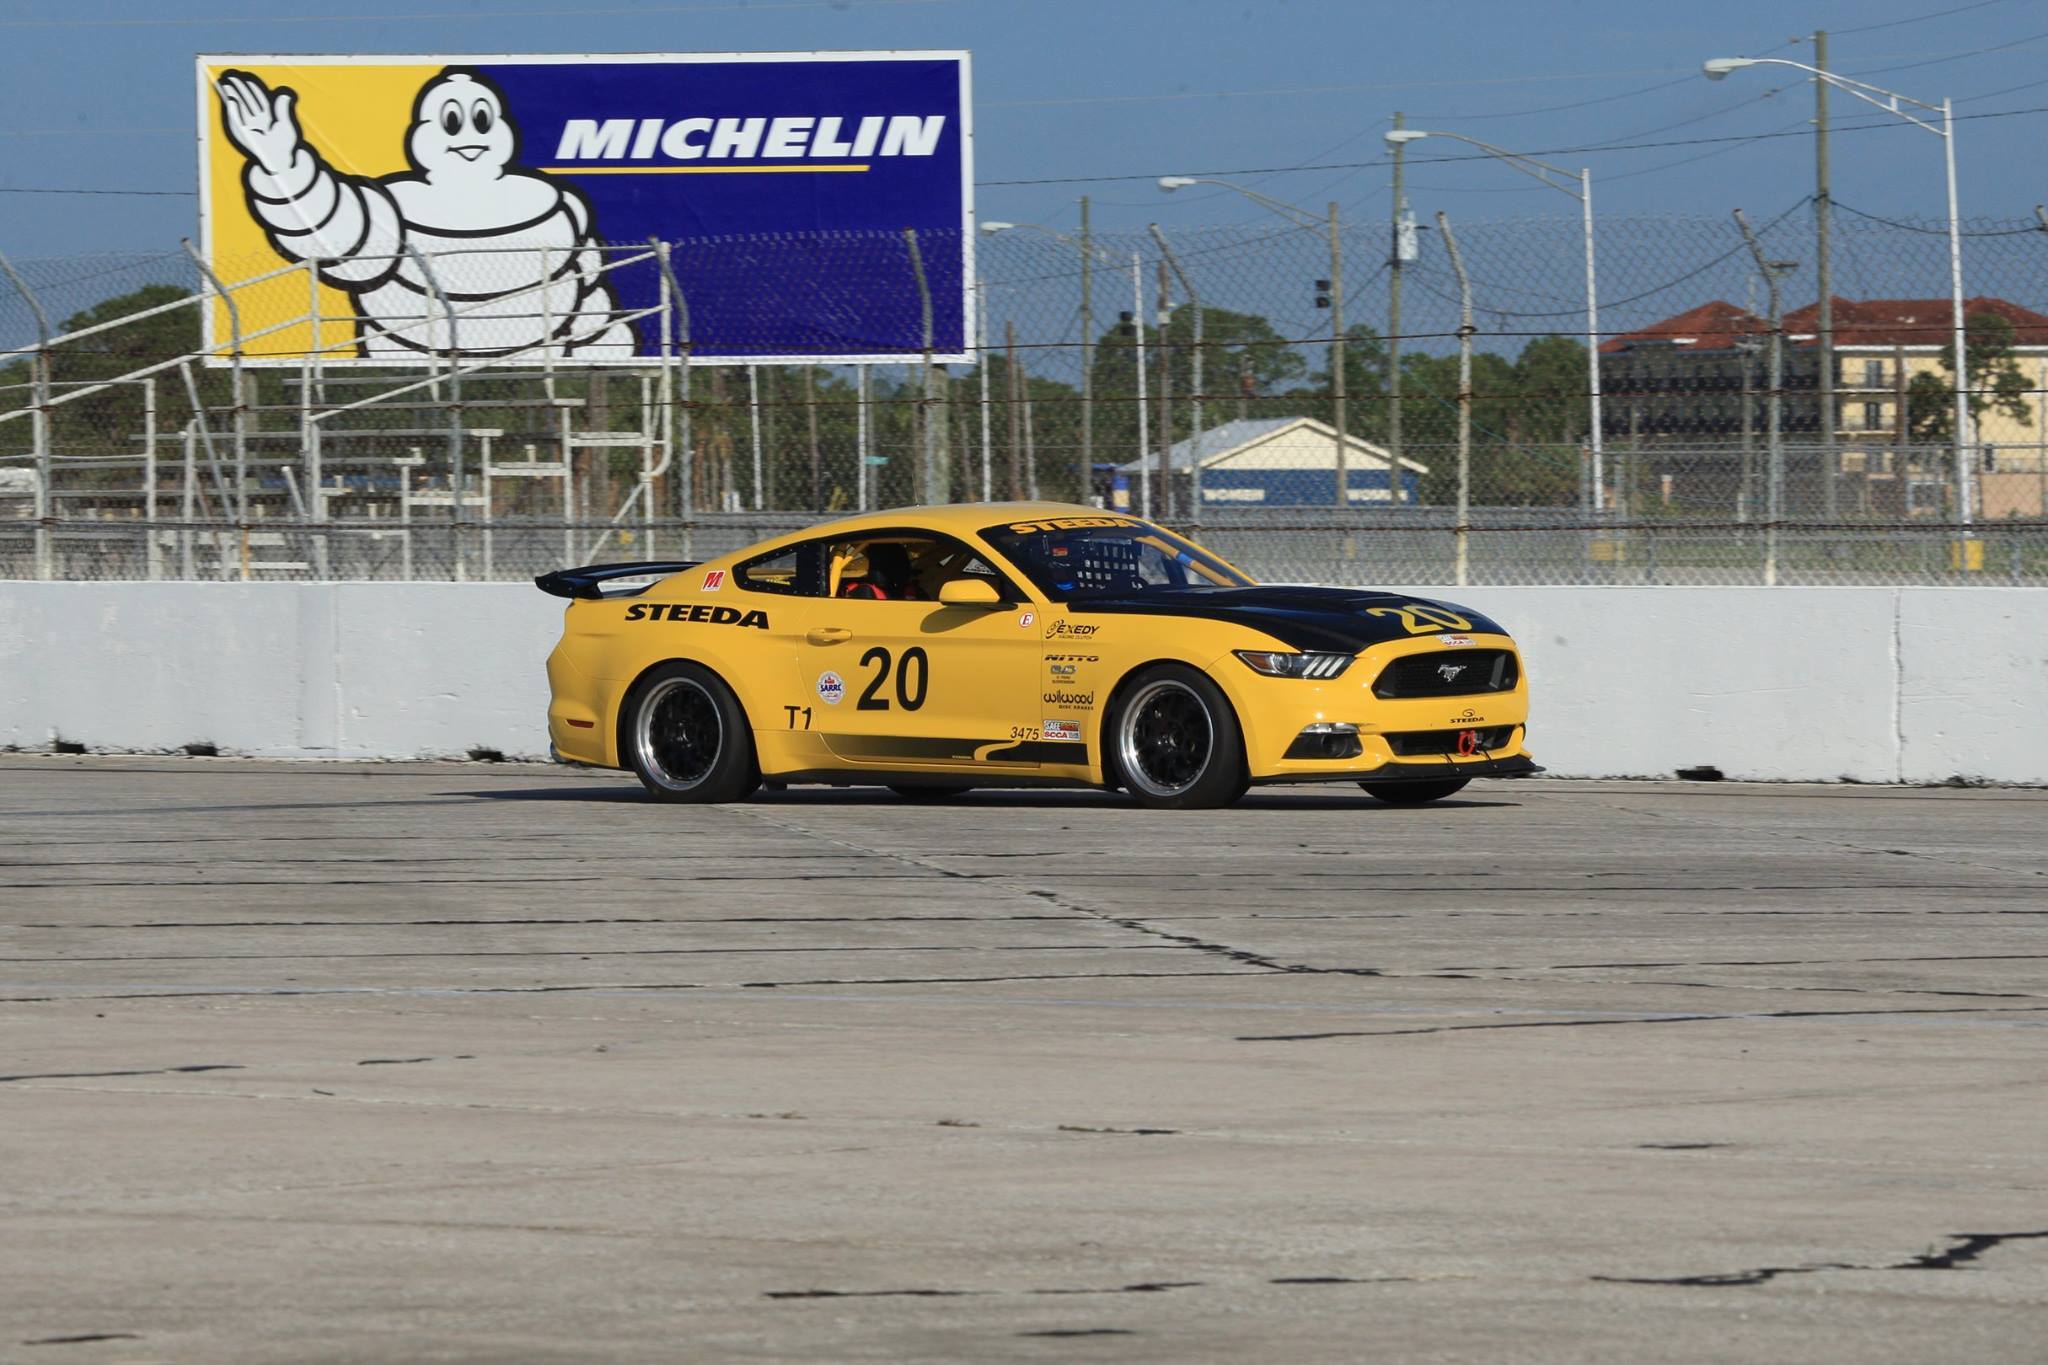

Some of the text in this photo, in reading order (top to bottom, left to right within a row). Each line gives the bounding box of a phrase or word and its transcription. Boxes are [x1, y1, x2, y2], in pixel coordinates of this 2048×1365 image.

[555, 115, 946, 160] MICHELIN
[1009, 518, 1142, 534] STEEDA
[625, 603, 769, 630] STEEDA
[1365, 605, 1472, 634] 20
[1056, 624, 1100, 635] EXEDY
[856, 646, 928, 711] 20
[1043, 689, 1094, 704] wilwood
[784, 705, 812, 730] T1
[1450, 716, 1485, 724] STEEDA
[1010, 726, 1040, 740] 3475
